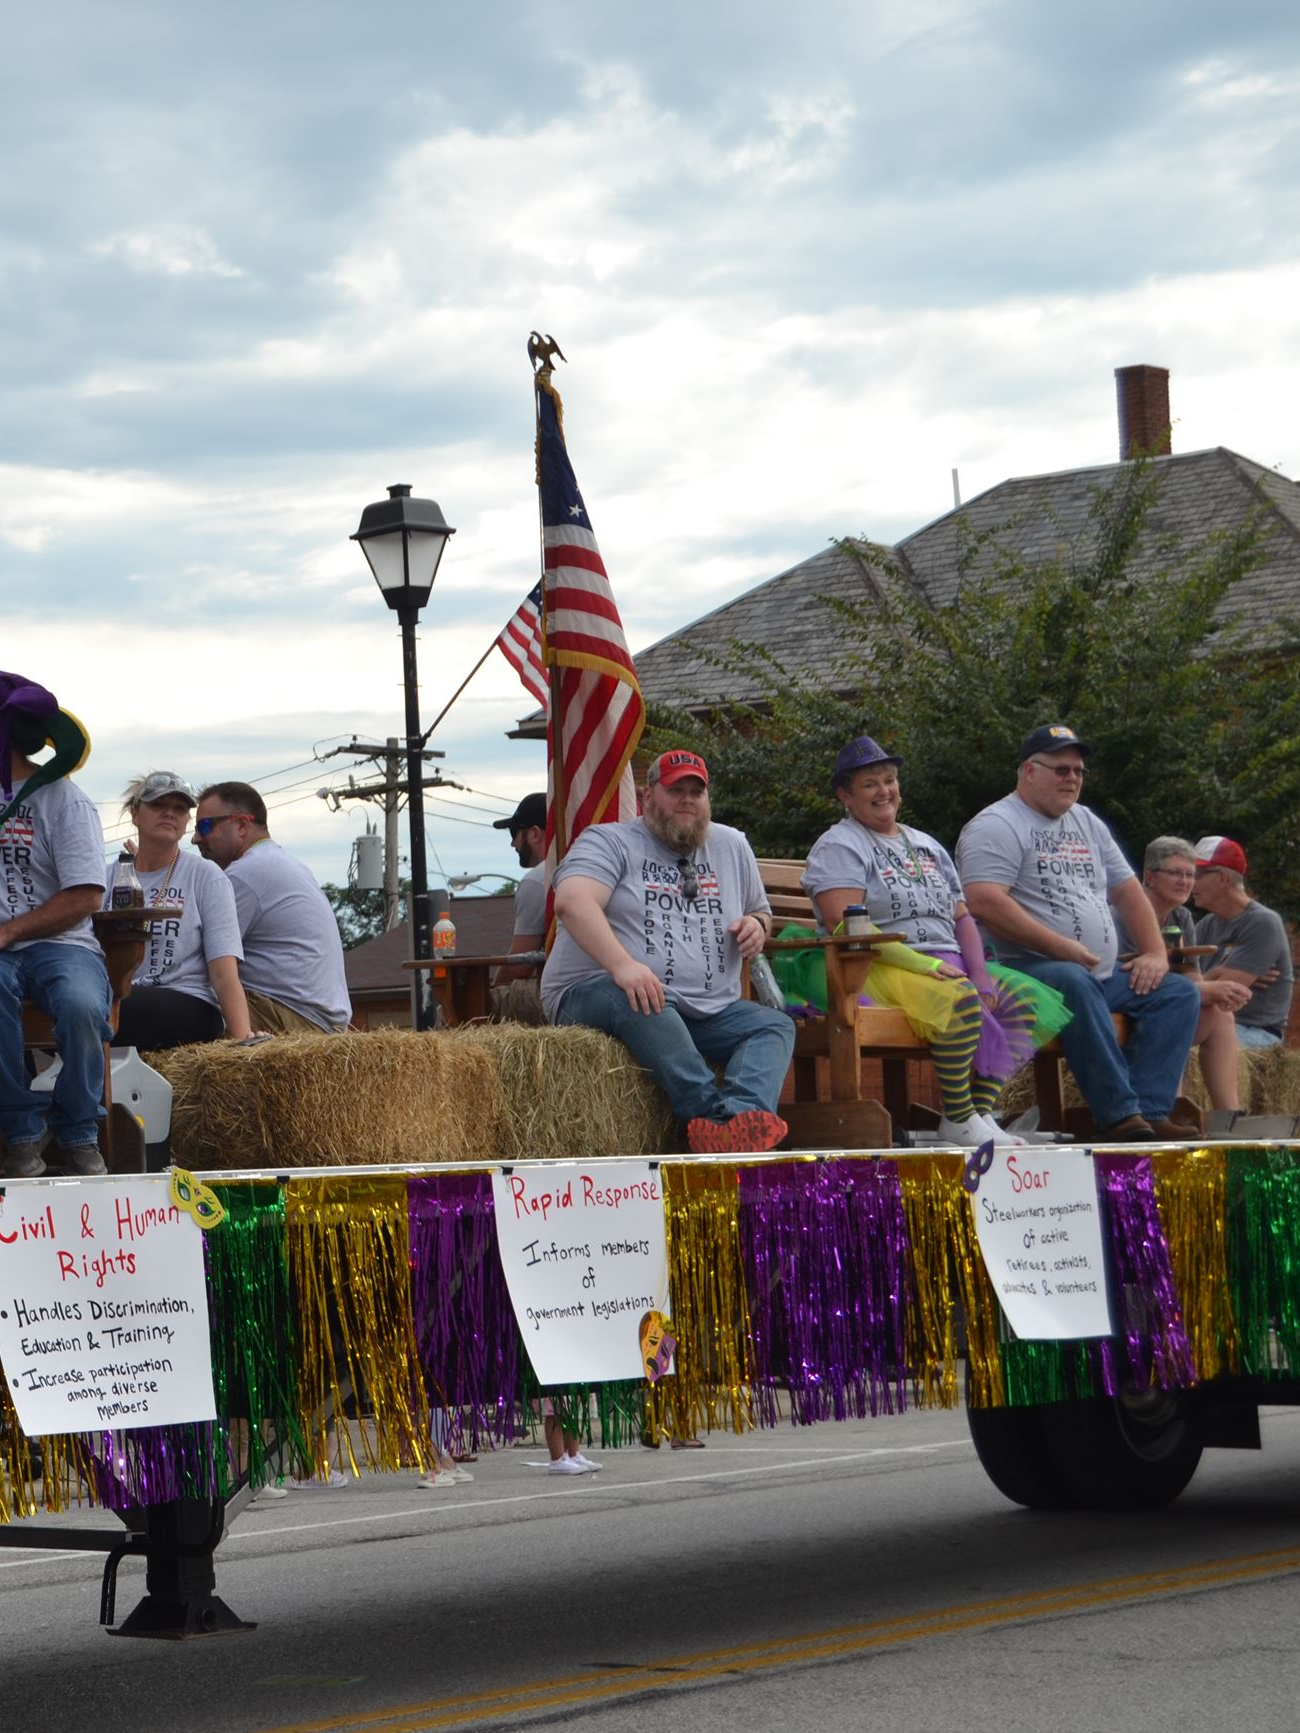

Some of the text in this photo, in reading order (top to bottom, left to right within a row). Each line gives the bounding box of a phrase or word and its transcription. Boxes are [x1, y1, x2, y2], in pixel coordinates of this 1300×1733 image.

[669, 753, 700, 767] USA
[1037, 859, 1096, 878] POWER
[644, 889, 724, 915] POWER
[1006, 1155, 1050, 1193] Soar
[508, 1175, 660, 1220] Rapid Response
[982, 1197, 1045, 1224] Steelworkers
[80, 1203, 95, 1239] &
[115, 1198, 180, 1241] Human
[1041, 1229, 1069, 1244] active
[523, 1239, 650, 1267] Informs members
[57, 1249, 136, 1287] Rights
[582, 1266, 596, 1289] of
[1041, 1279, 1053, 1296] &
[1055, 1280, 1097, 1294] volunteers
[13, 1299, 82, 1329] Handles
[526, 1294, 655, 1330] government legislations
[21, 1323, 175, 1356] Education & Training
[22, 1357, 173, 1391] Increase participation
[67, 1379, 158, 1402] among diverse
